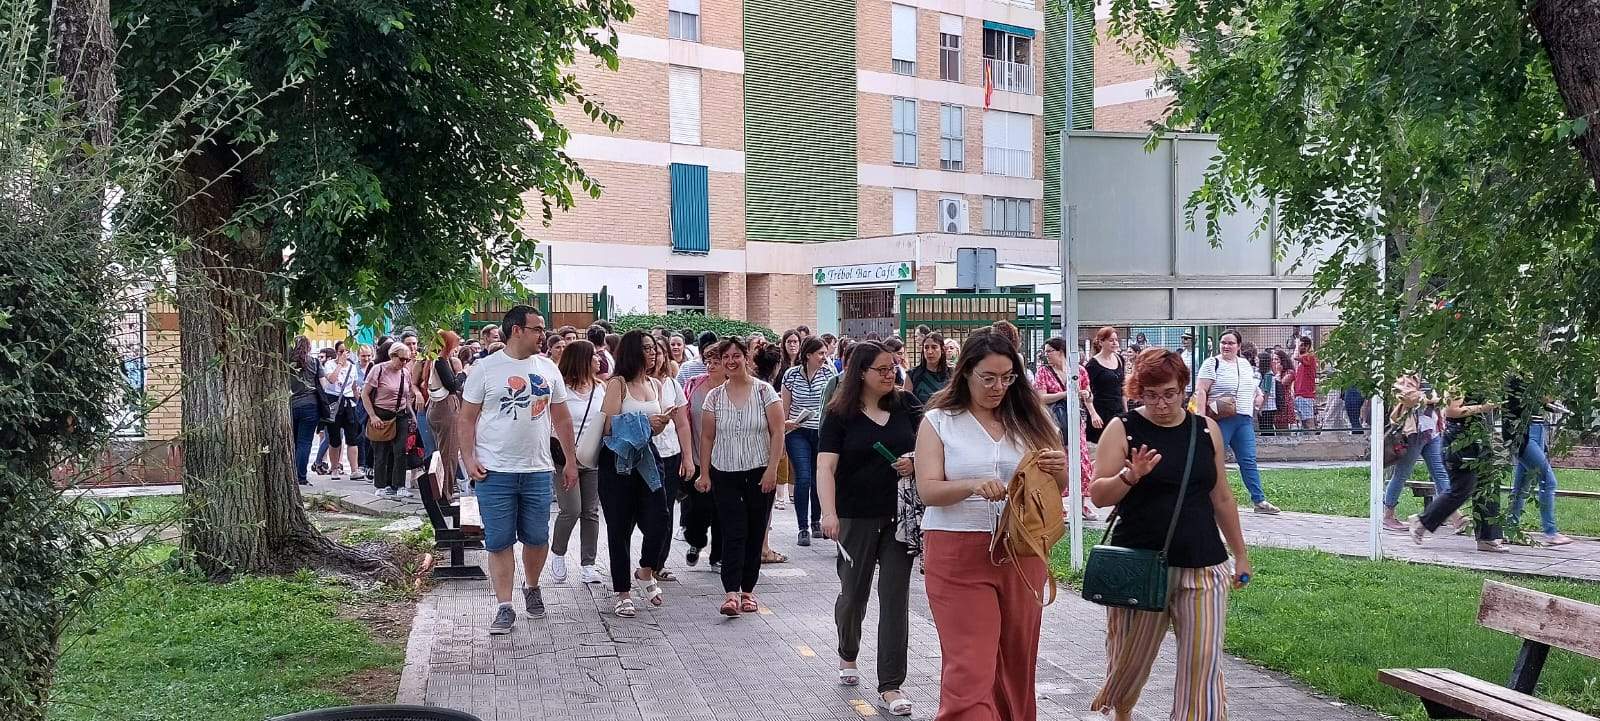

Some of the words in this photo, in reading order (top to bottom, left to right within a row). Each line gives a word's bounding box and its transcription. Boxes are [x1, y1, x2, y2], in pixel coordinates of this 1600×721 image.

[827, 267, 853, 281] Trébol
[855, 268, 872, 279] Bar
[875, 264, 895, 281] Café
